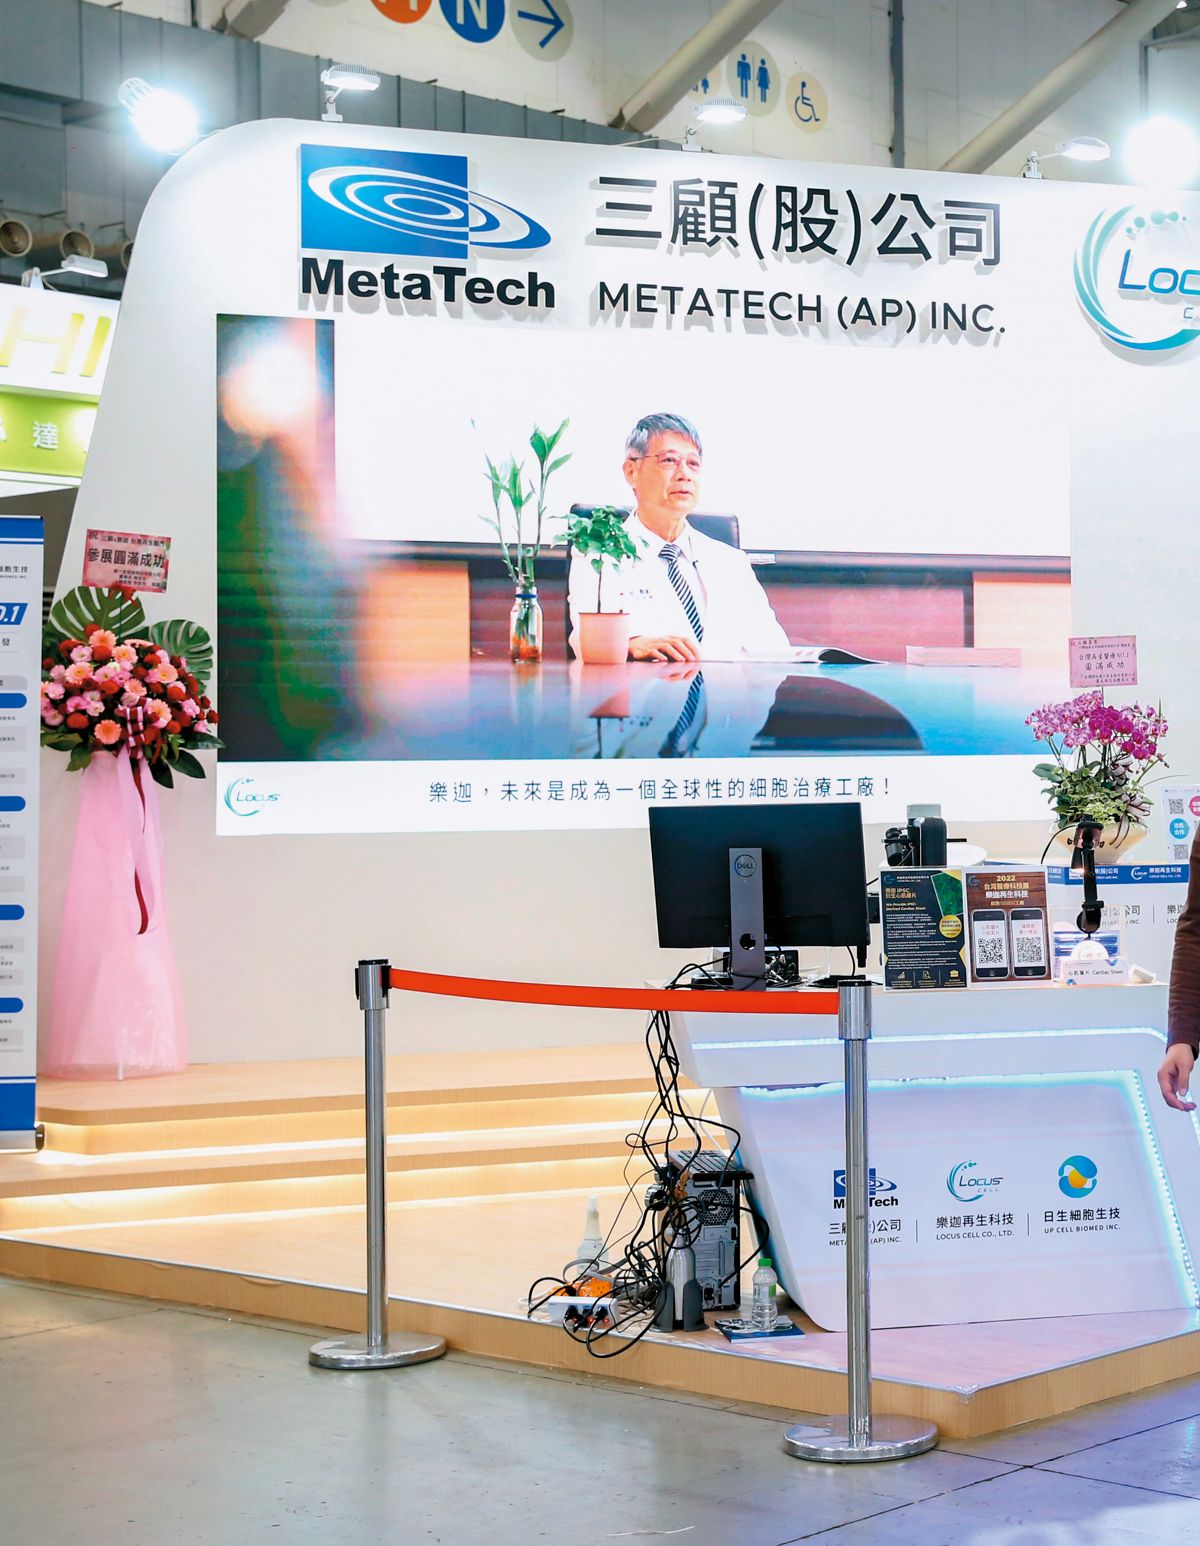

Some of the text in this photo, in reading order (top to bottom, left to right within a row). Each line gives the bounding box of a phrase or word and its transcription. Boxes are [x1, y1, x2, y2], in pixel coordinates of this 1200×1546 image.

[596, 176, 1000, 266] 三顧(股)公司
[301, 257, 556, 308] MetaTech
[599, 281, 1005, 333] METATECH (AP) INC.
[833, 1193, 899, 1210] MTech
[936, 1212, 1014, 1229] 樂迦再生科技
[1044, 1206, 1121, 1223] 日生細胞生技
[936, 1233, 961, 1241] LOCUS
[962, 1231, 980, 1239] CELL
[998, 1229, 1015, 1237] LTD.
